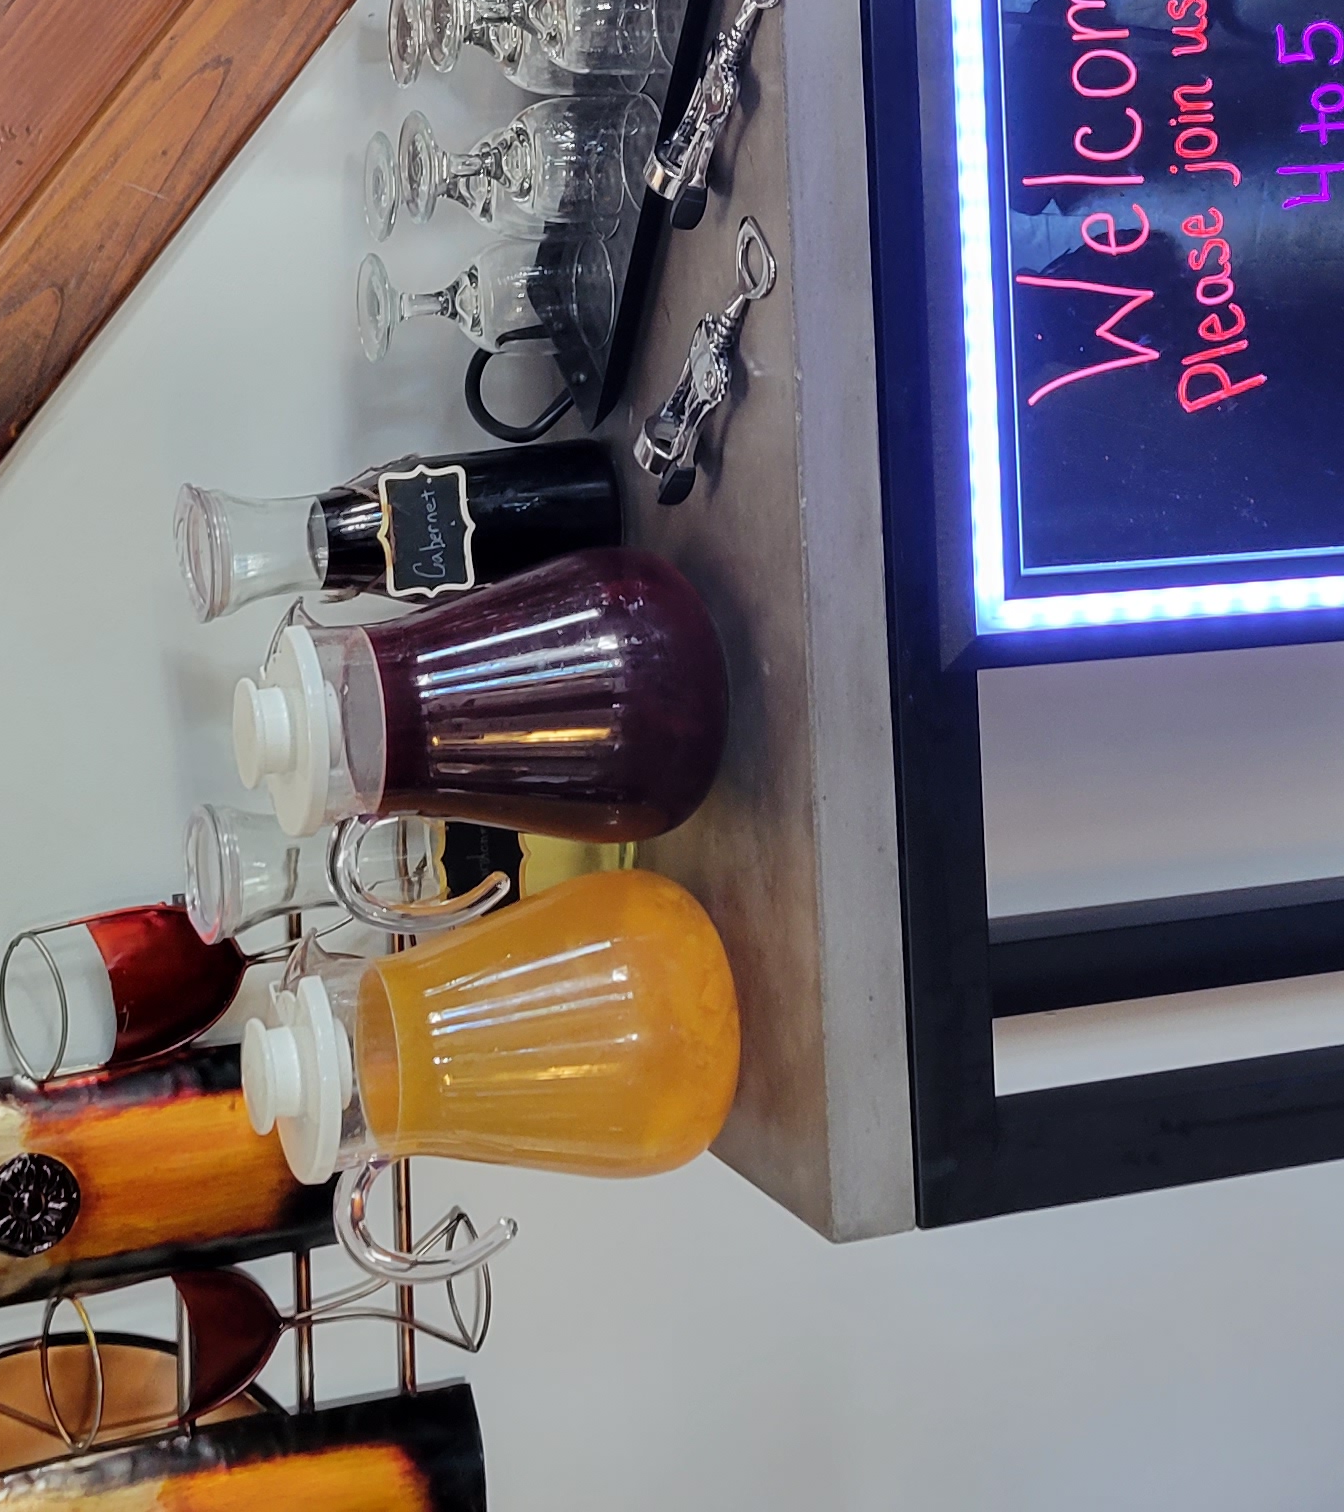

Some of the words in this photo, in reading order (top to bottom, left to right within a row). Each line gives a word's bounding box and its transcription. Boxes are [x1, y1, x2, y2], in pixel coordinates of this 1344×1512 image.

[1275, 20, 1344, 66] 5
[1169, 78, 1242, 187] join
[1177, 206, 1267, 413] Please
[412, 490, 446, 578] Cabernet
